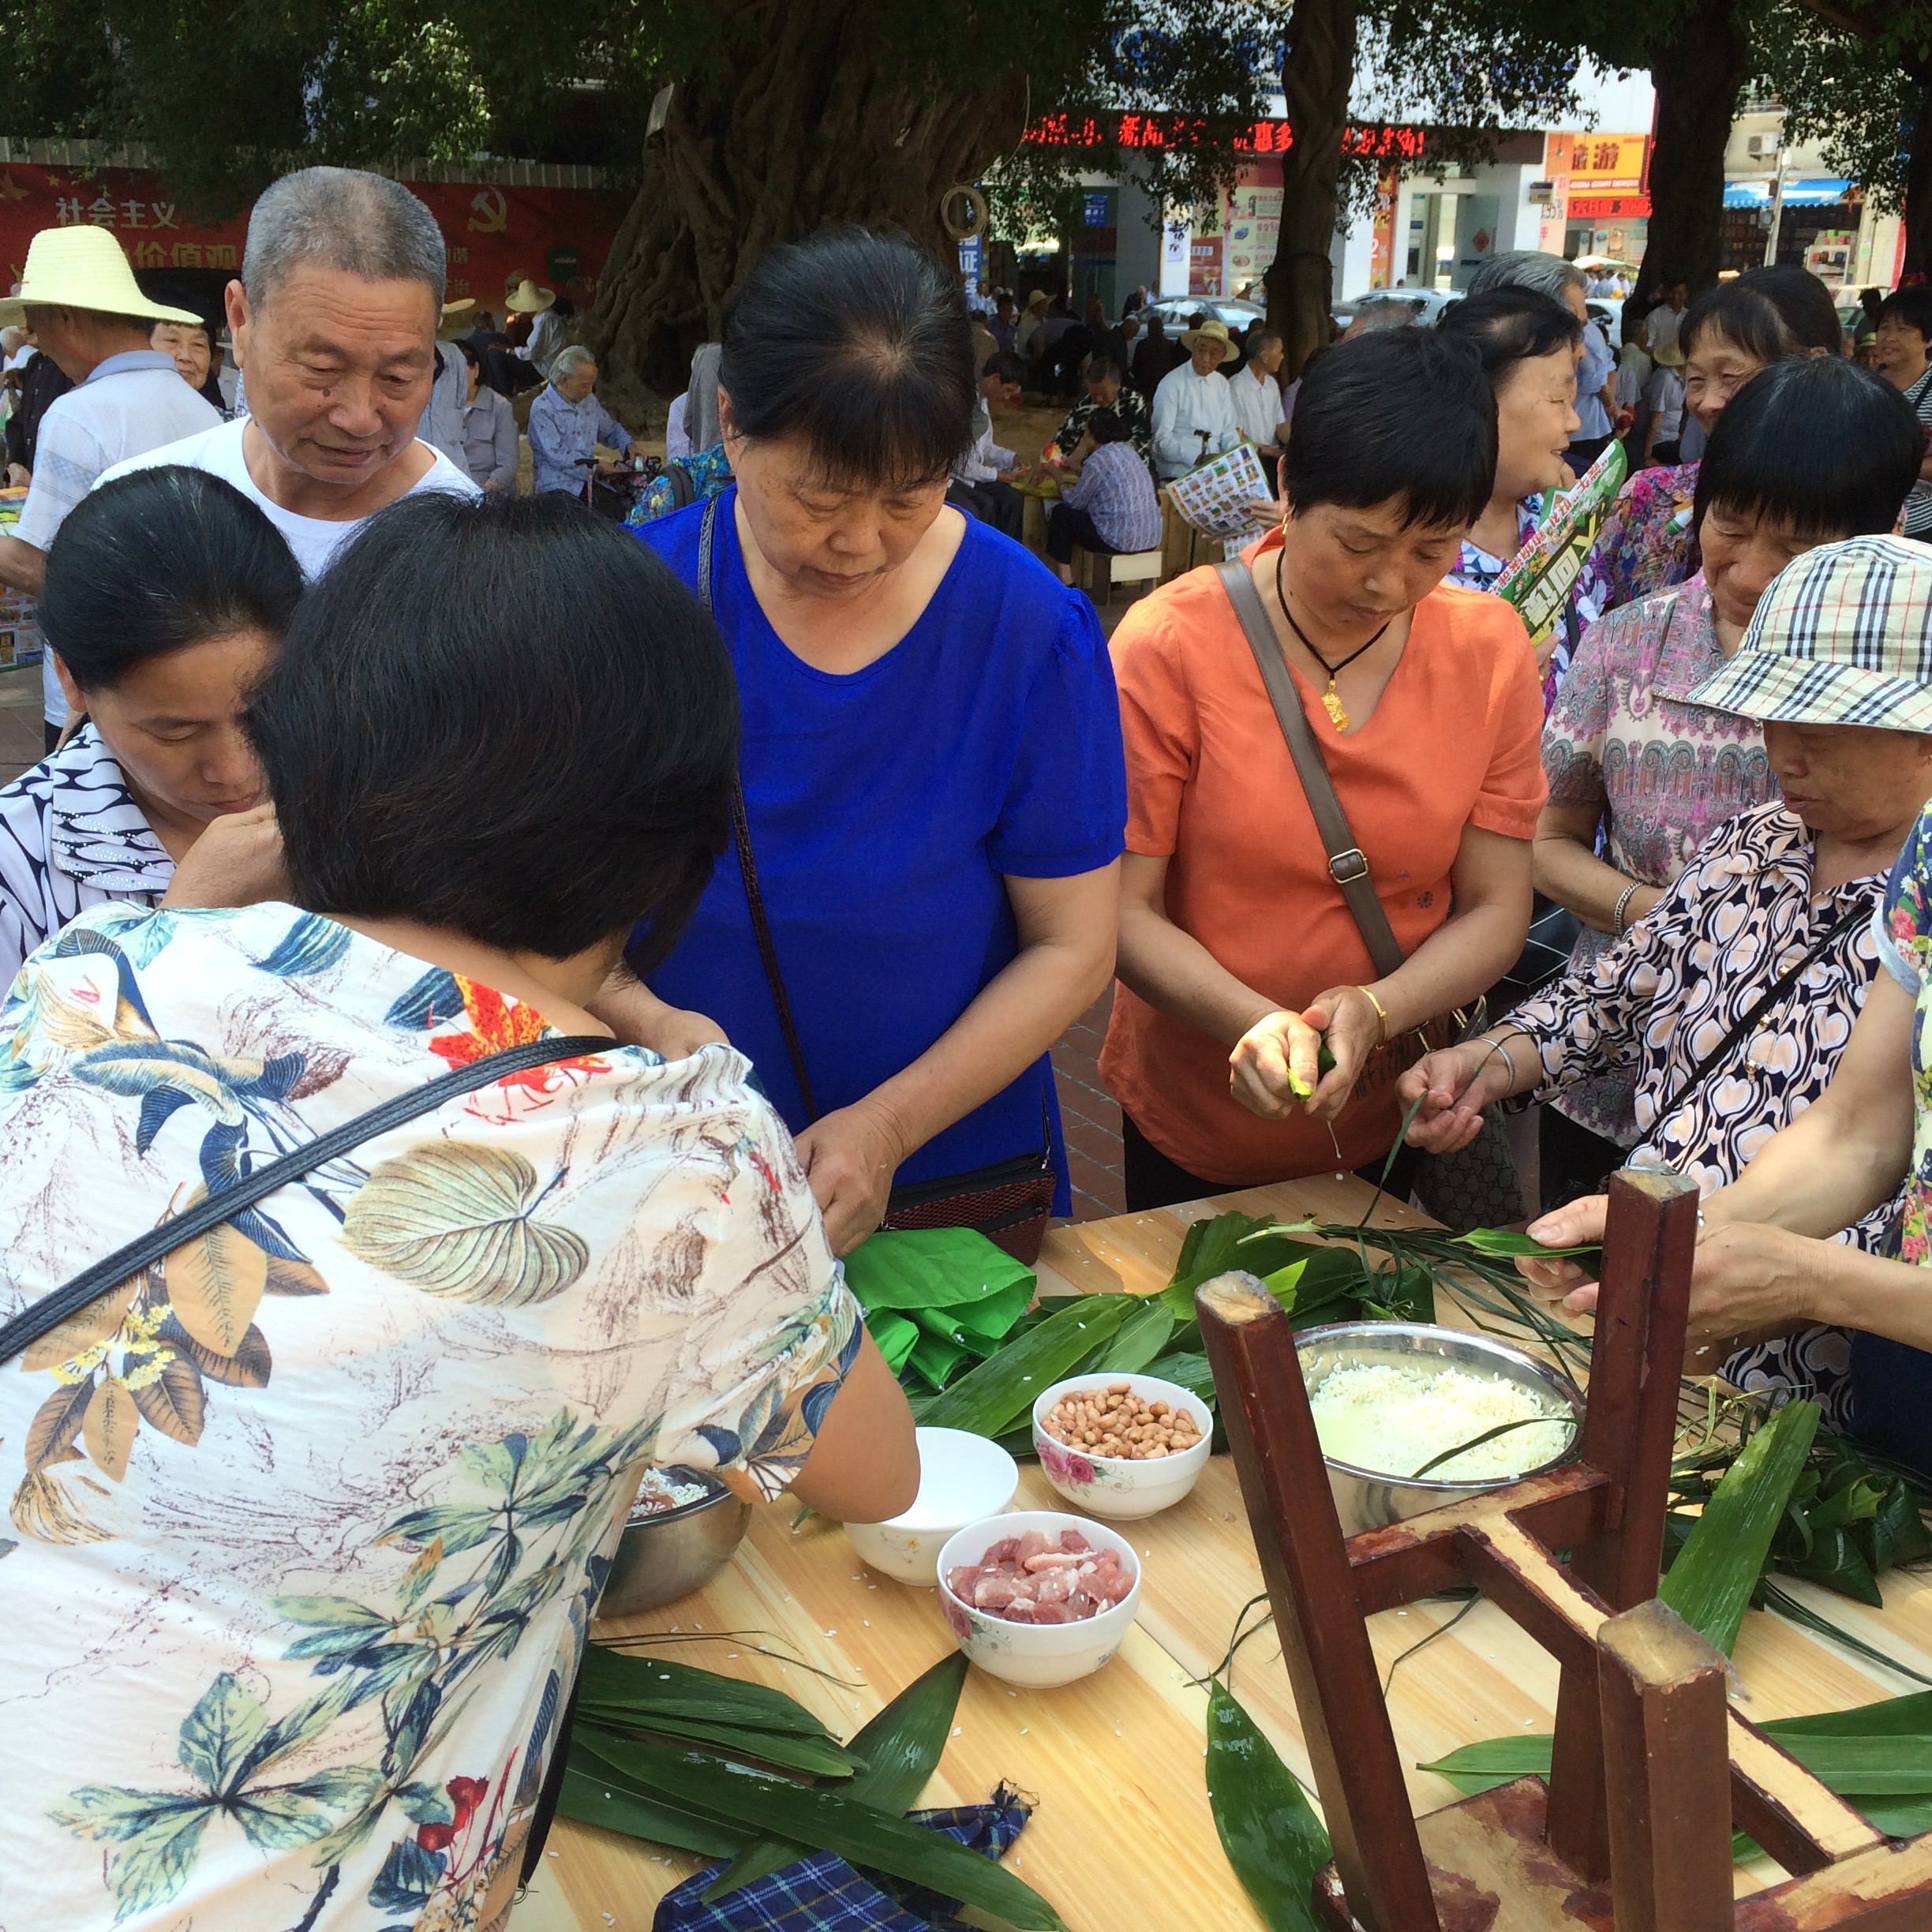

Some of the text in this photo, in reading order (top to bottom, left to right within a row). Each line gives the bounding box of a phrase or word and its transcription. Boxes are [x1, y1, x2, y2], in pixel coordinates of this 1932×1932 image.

[55, 197, 180, 229] 社会主义
[123, 241, 237, 269] 价值观
[1489, 527, 1546, 595] 购物满就
